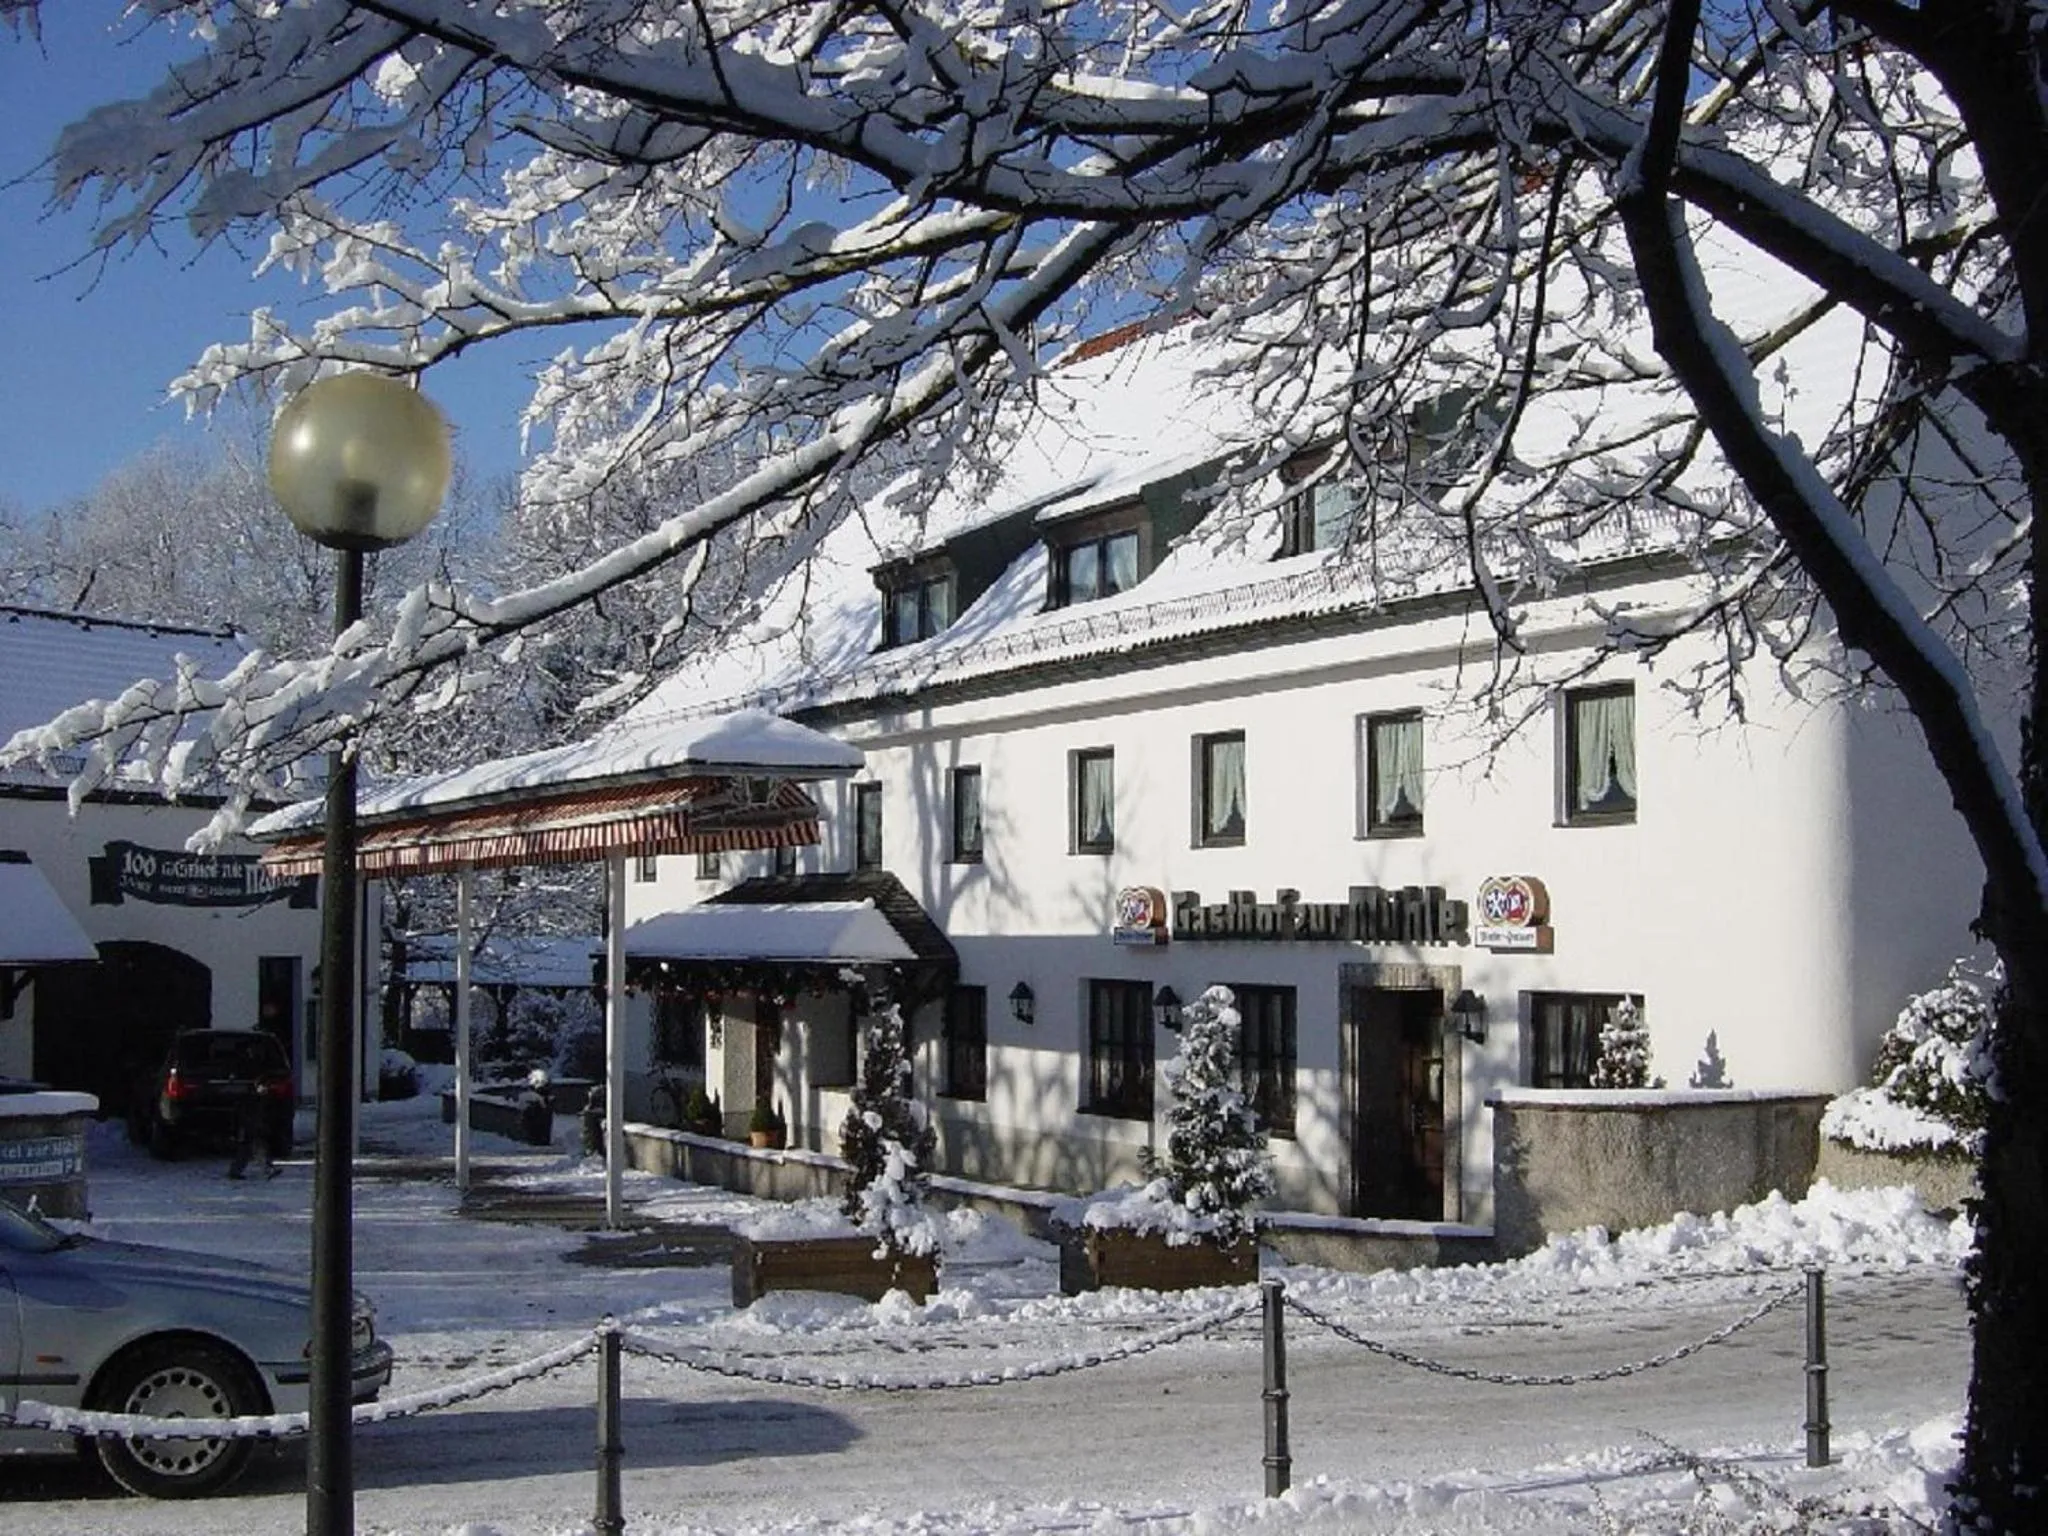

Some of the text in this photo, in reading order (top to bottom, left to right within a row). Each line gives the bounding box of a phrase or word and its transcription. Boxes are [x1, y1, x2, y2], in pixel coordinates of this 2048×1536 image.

[122, 850, 157, 877] 100
[1171, 888, 1293, 938] Gasthof
[1295, 903, 1347, 938] zur
